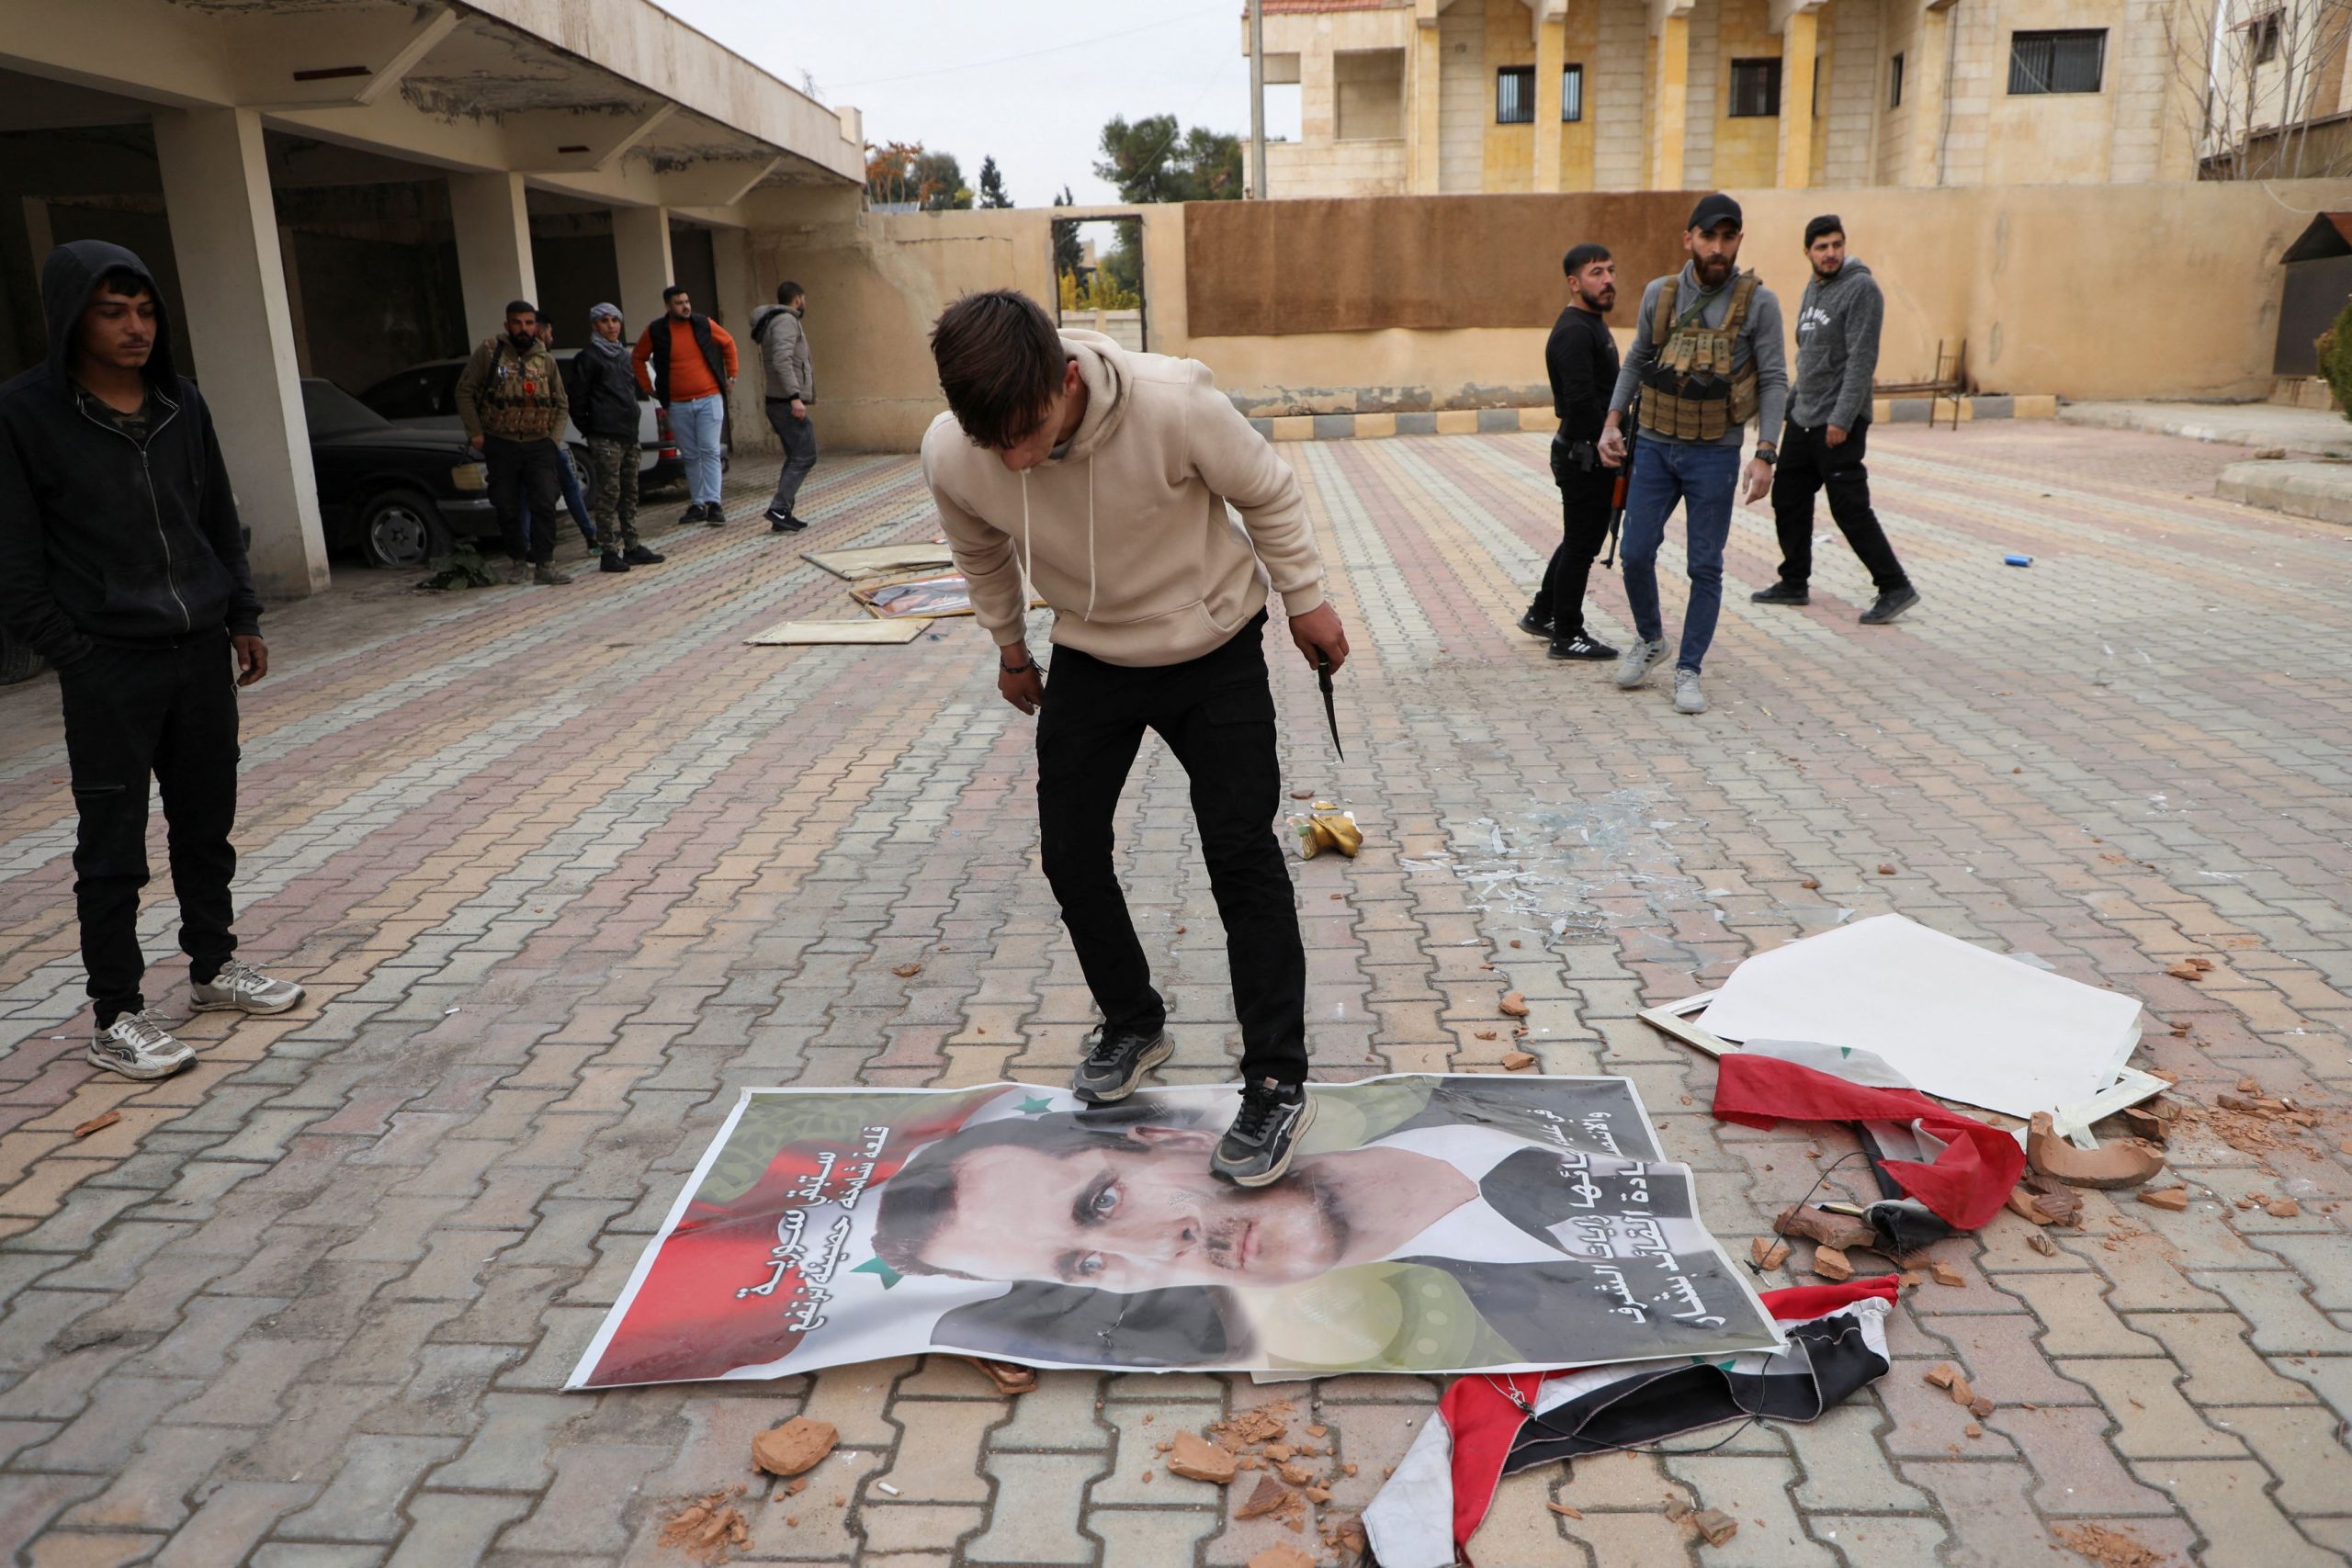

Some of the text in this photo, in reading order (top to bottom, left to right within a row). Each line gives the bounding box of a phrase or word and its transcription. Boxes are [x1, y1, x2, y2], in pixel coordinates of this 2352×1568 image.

[736, 1151, 836, 1299] ستبقى سورية
[784, 1126, 890, 1332] قلعة شامخة حصينة ترتفع
[1574, 1214, 1616, 1259] رايات
[1620, 1210, 1680, 1271] القائد
[1653, 1272, 1727, 1326] بشار
[1591, 1264, 1648, 1325] الشرف
